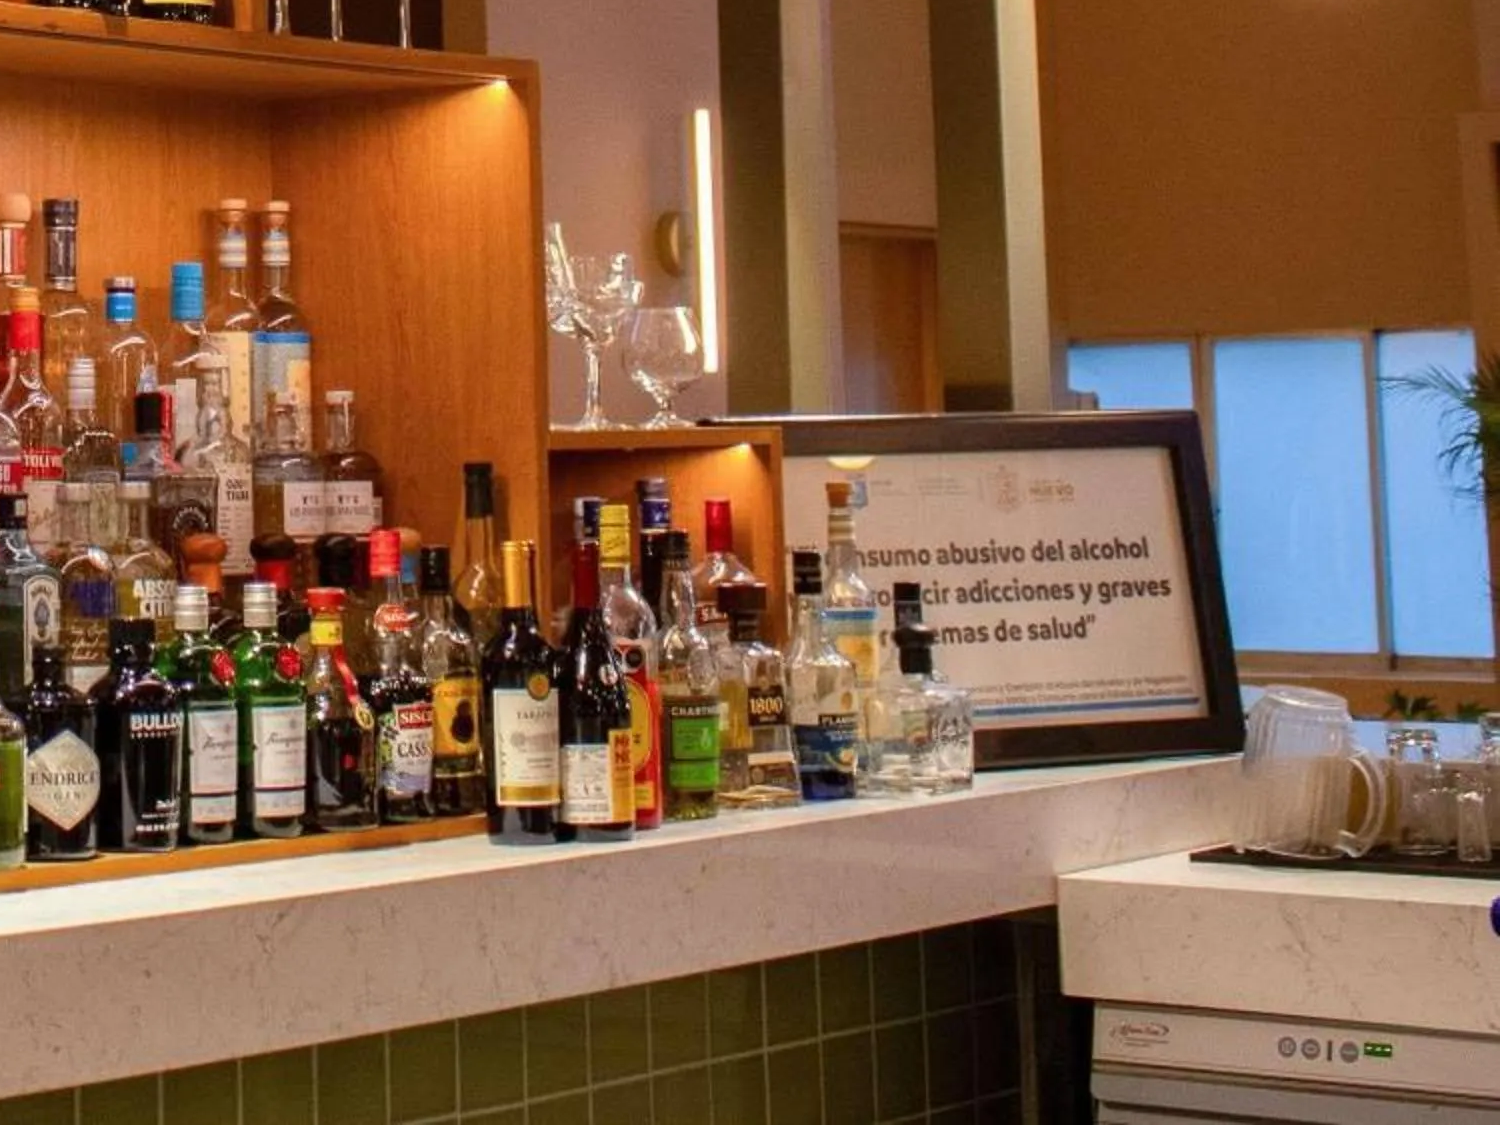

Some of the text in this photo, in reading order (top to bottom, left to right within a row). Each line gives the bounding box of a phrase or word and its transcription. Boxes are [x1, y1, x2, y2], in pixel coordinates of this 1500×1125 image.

[936, 537, 1026, 567] abusivo
[1031, 539, 1065, 563] del
[1069, 536, 1150, 563] alcohol
[955, 578, 1075, 605] adicciones
[1079, 583, 1094, 607] y
[1098, 580, 1172, 606] graves
[994, 619, 1024, 644] de
[750, 696, 784, 714] 1800
[400, 711, 434, 724] SISC
[397, 741, 433, 759] CASS
